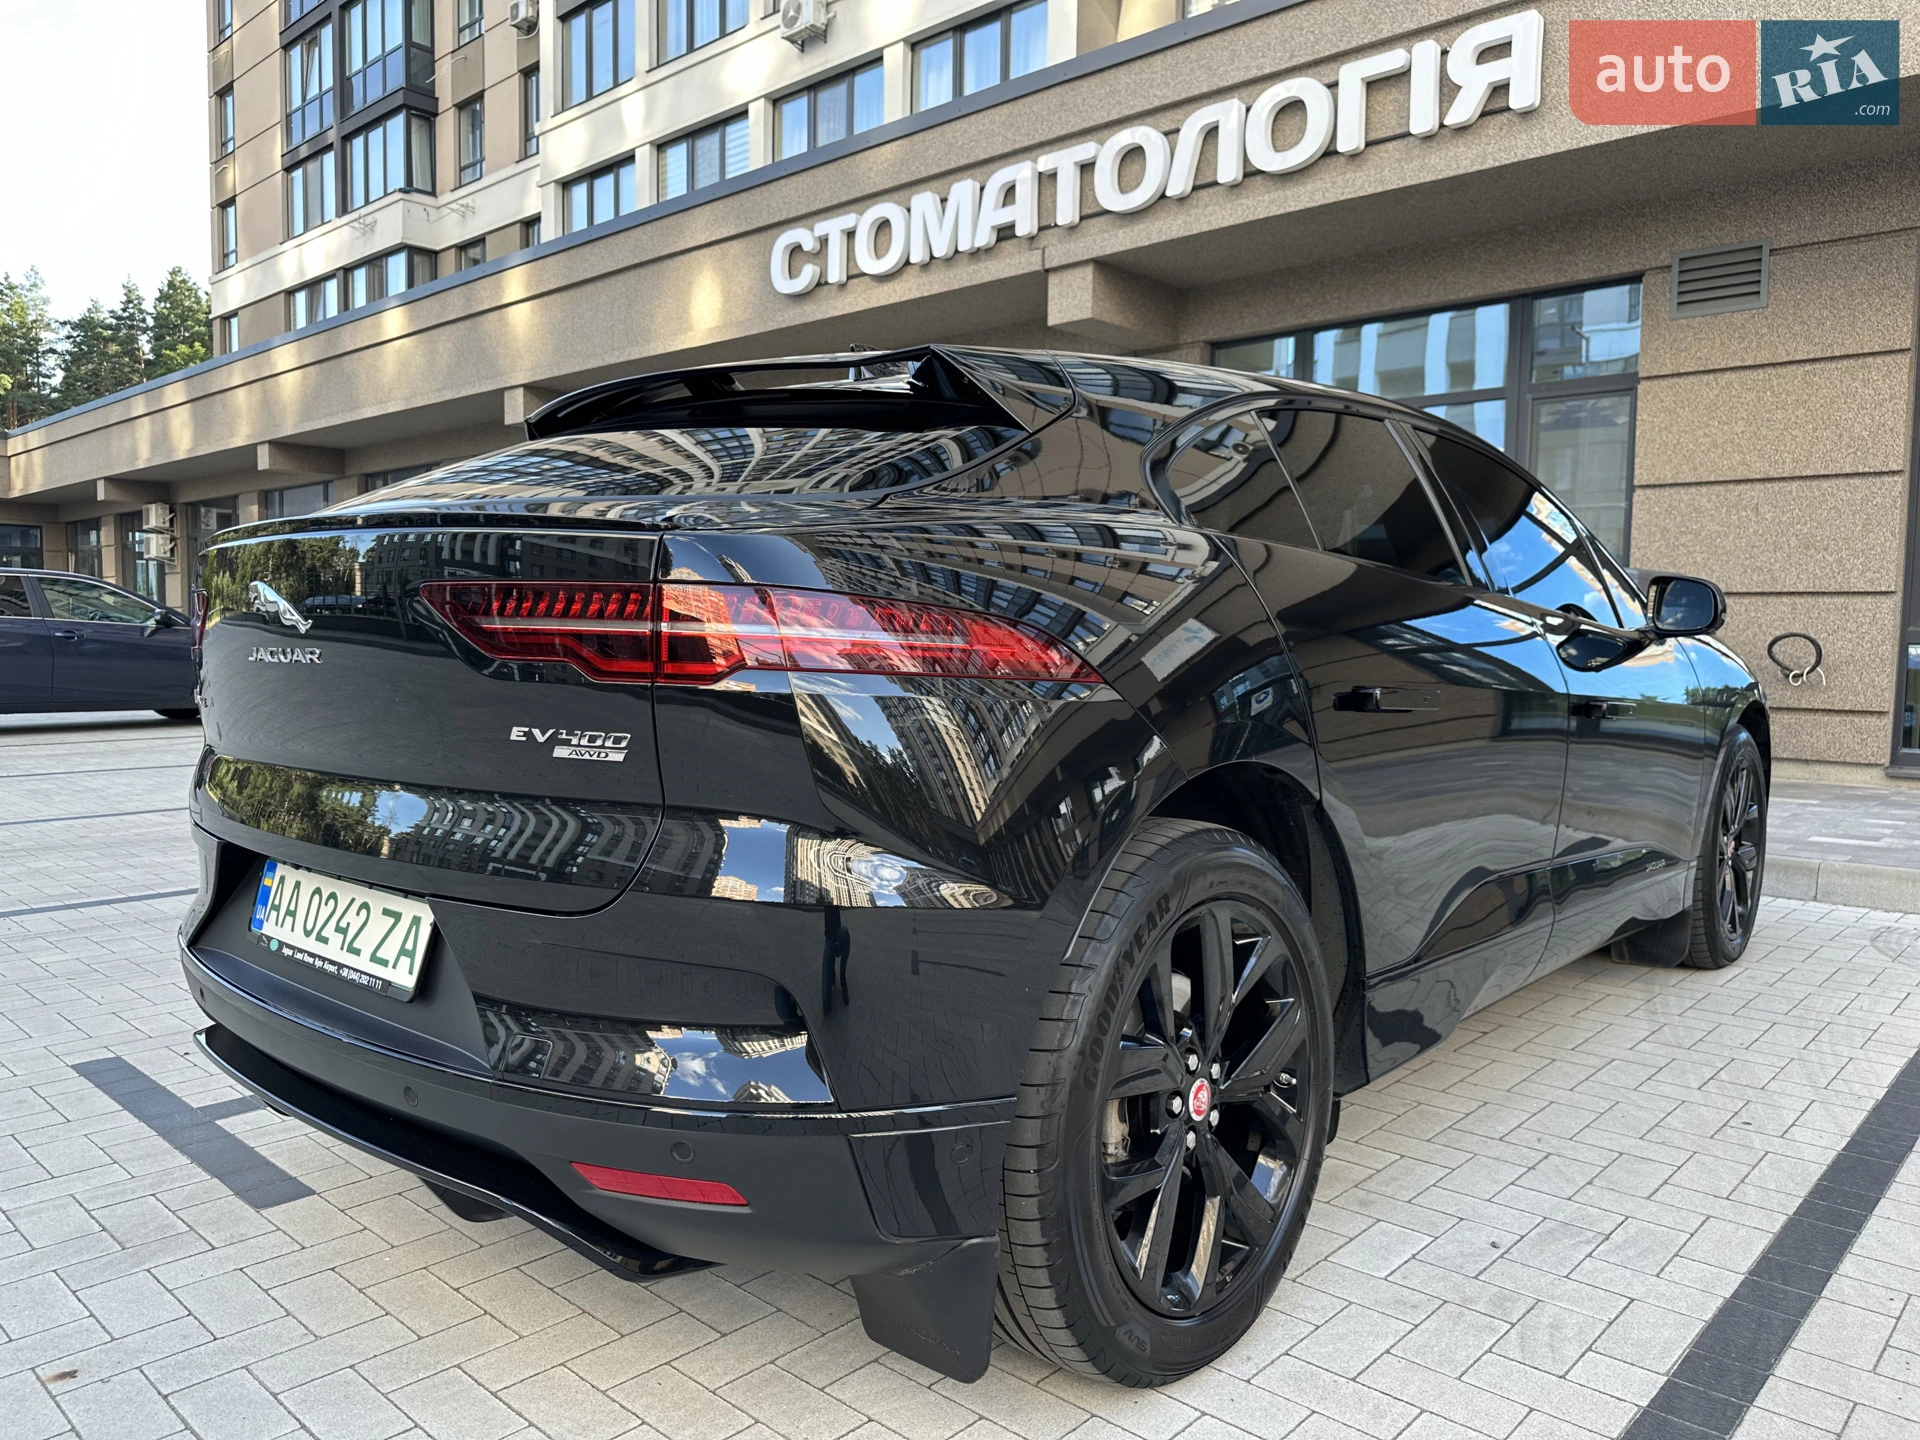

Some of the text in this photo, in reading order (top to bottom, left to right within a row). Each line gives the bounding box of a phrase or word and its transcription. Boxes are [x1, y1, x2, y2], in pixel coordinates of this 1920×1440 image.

[769, 9, 1544, 296] СТОМАТОЛОГІЯ
[248, 647, 323, 664] JAGUAR
[568, 749, 609, 759] AWD
[256, 904, 266, 921] UA
[302, 886, 371, 957] 0242
[369, 906, 422, 975] ZA
[281, 944, 294, 957] Jaguar
[293, 949, 304, 961] Land
[303, 952, 315, 965] Rover
